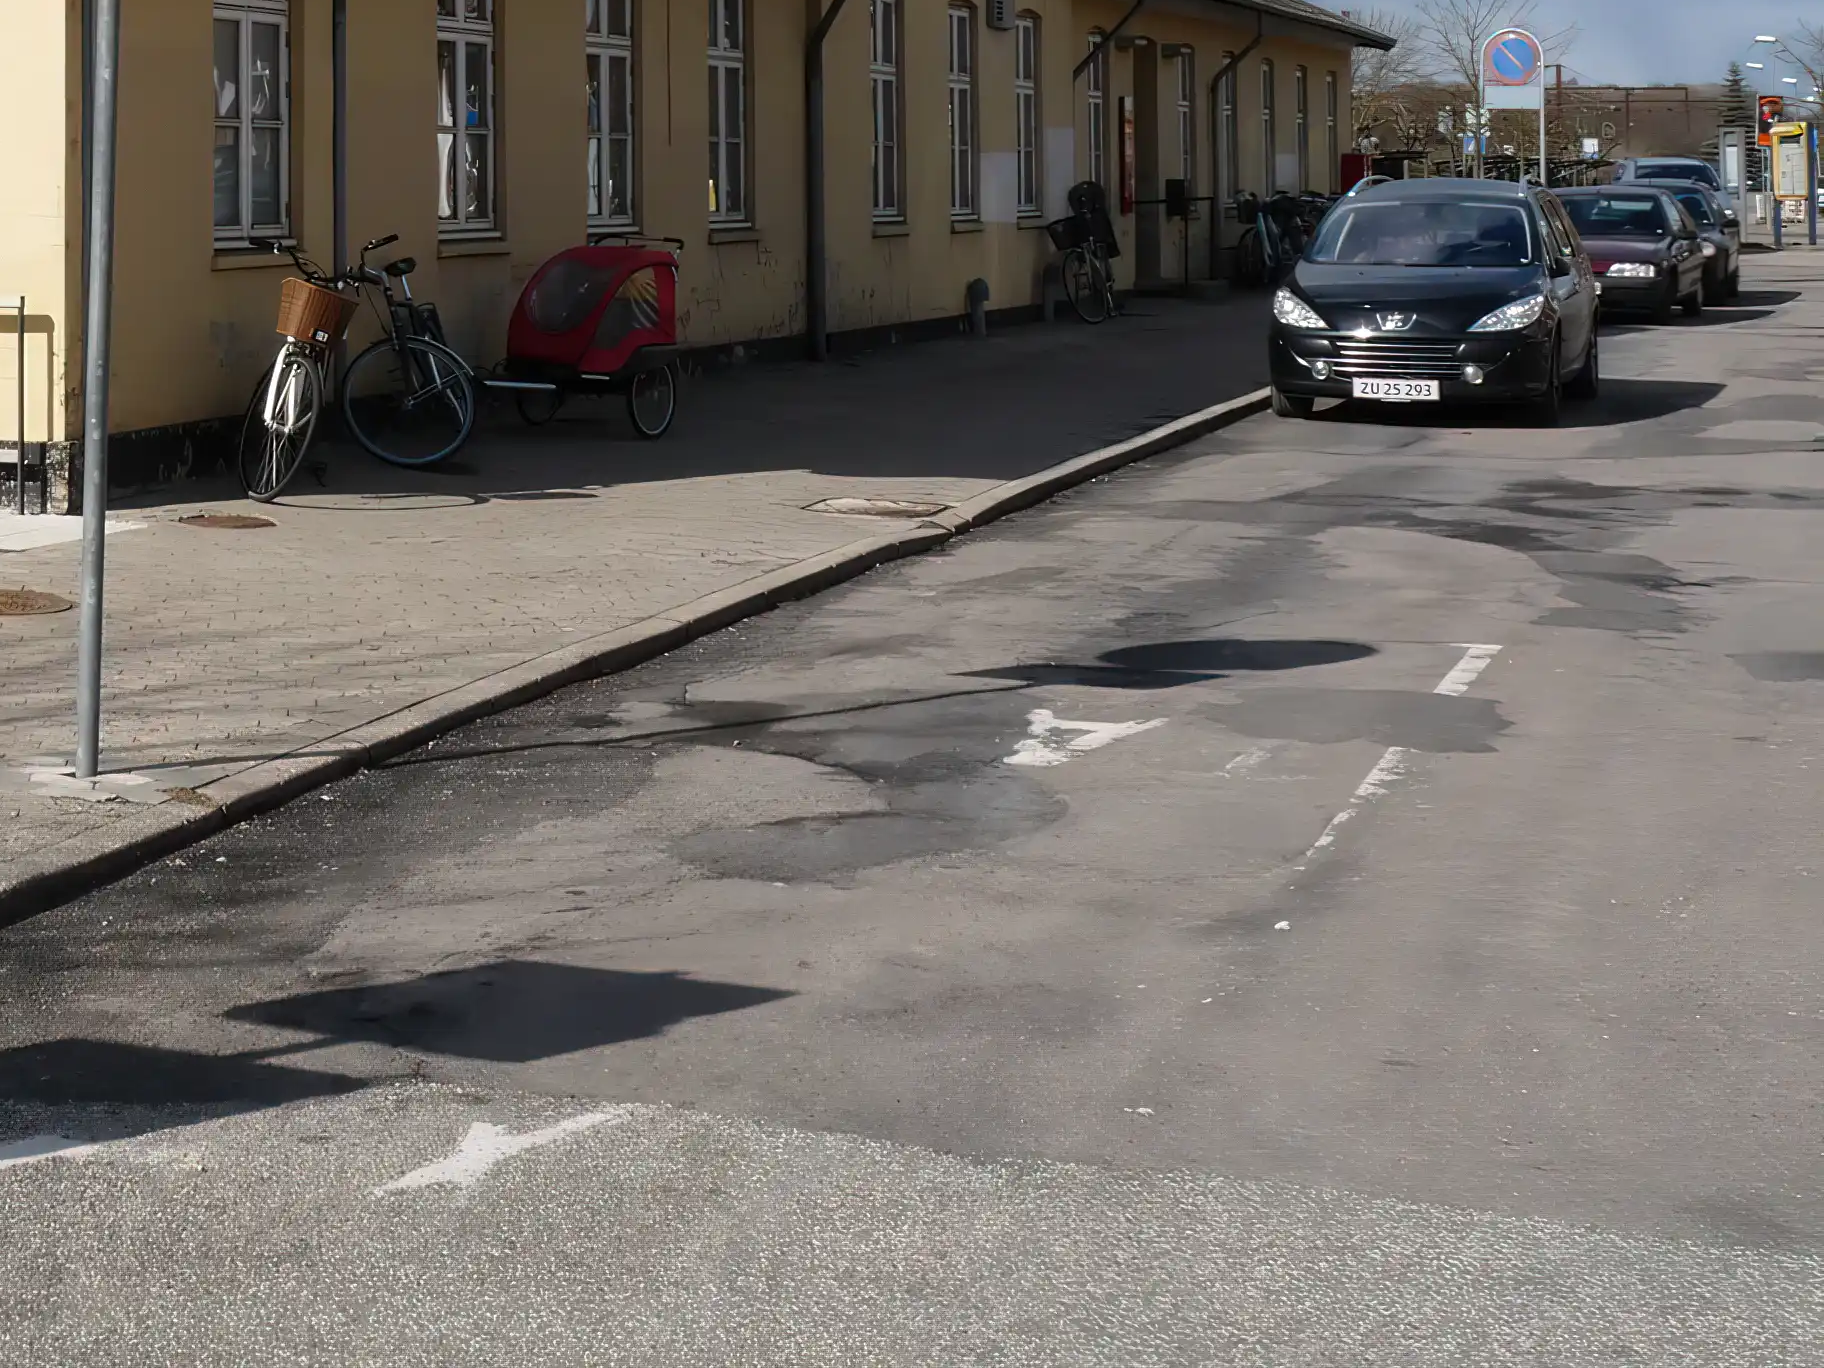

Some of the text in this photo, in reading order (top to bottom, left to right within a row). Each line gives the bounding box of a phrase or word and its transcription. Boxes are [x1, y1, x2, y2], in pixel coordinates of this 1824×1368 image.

[1360, 382, 1432, 397] ZU 25 293
